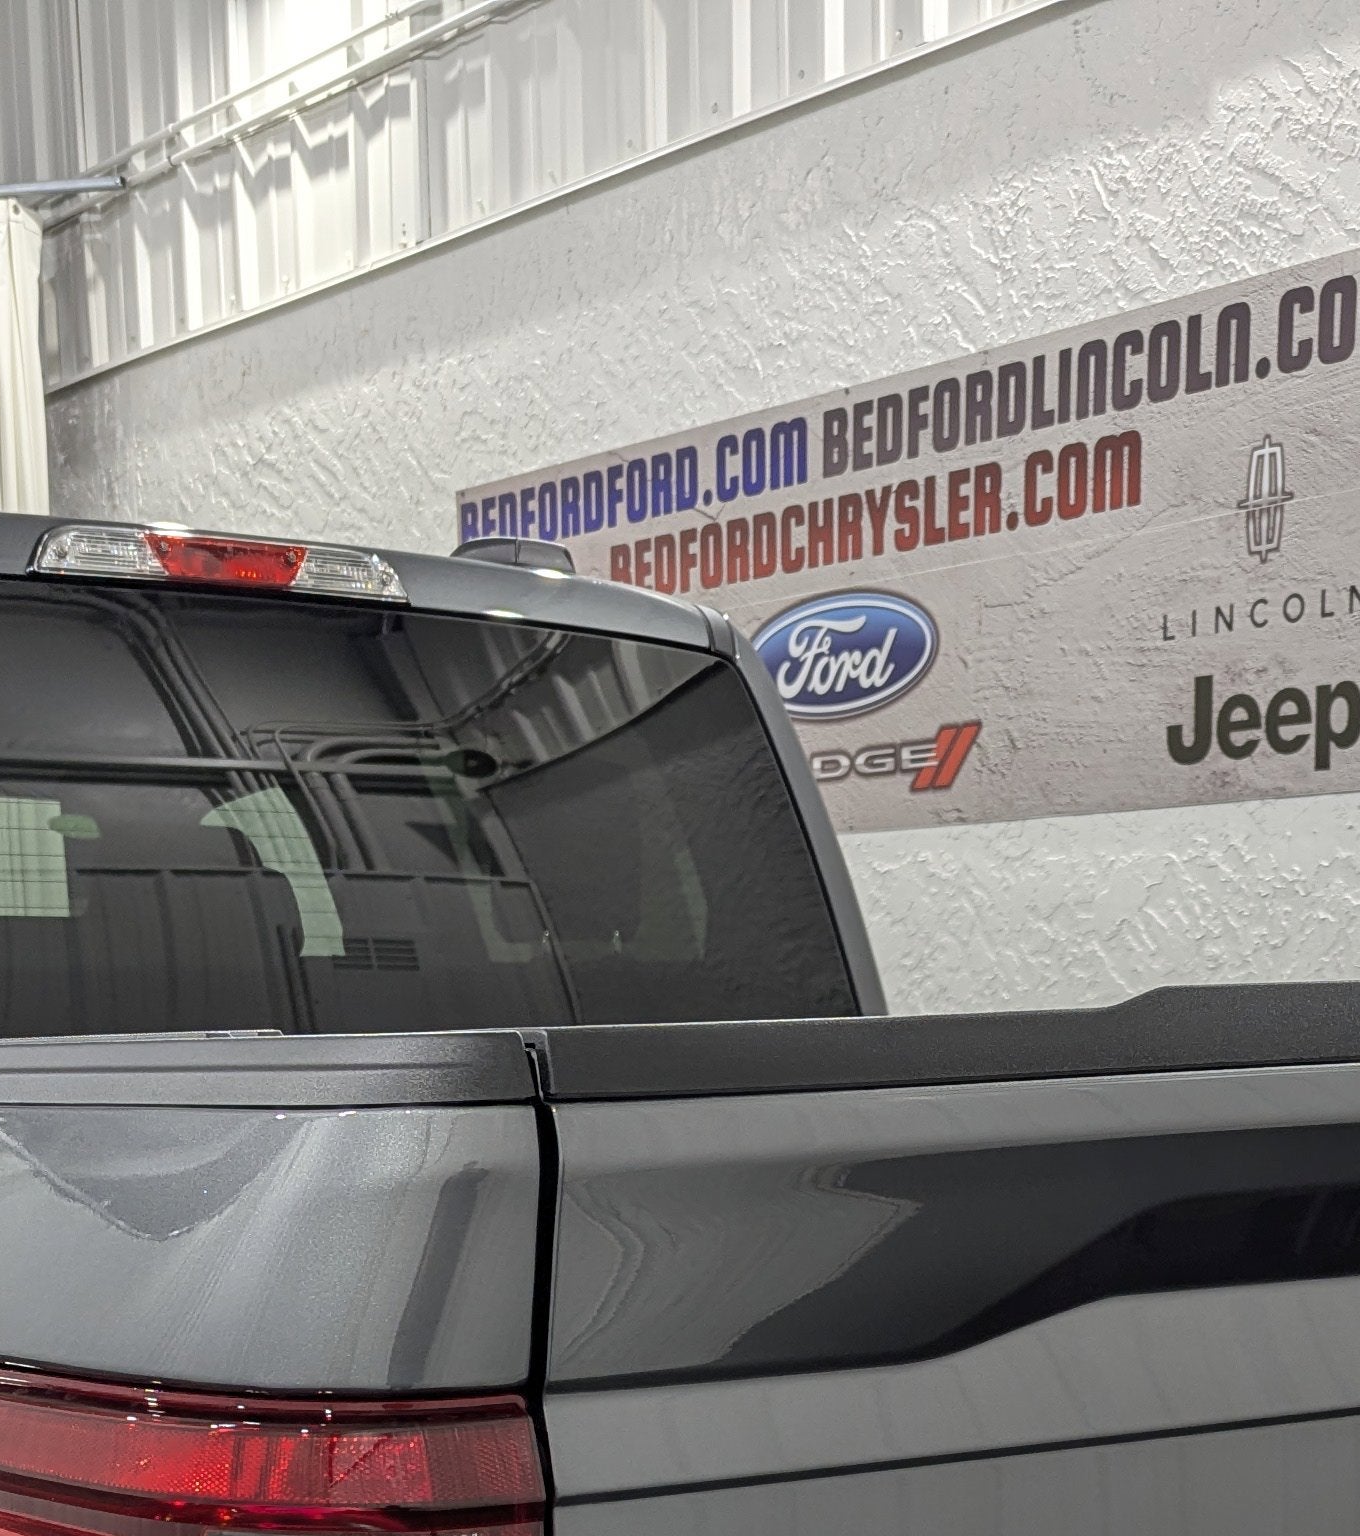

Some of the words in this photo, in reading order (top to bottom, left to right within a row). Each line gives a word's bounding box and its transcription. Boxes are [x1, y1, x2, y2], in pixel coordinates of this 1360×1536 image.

[461, 416, 808, 542] BEDFORDFORD.COM
[610, 429, 1142, 595] BEDFORDCHRYSLER.COM
[777, 615, 898, 699] Ford
[810, 739, 940, 781] DGE
